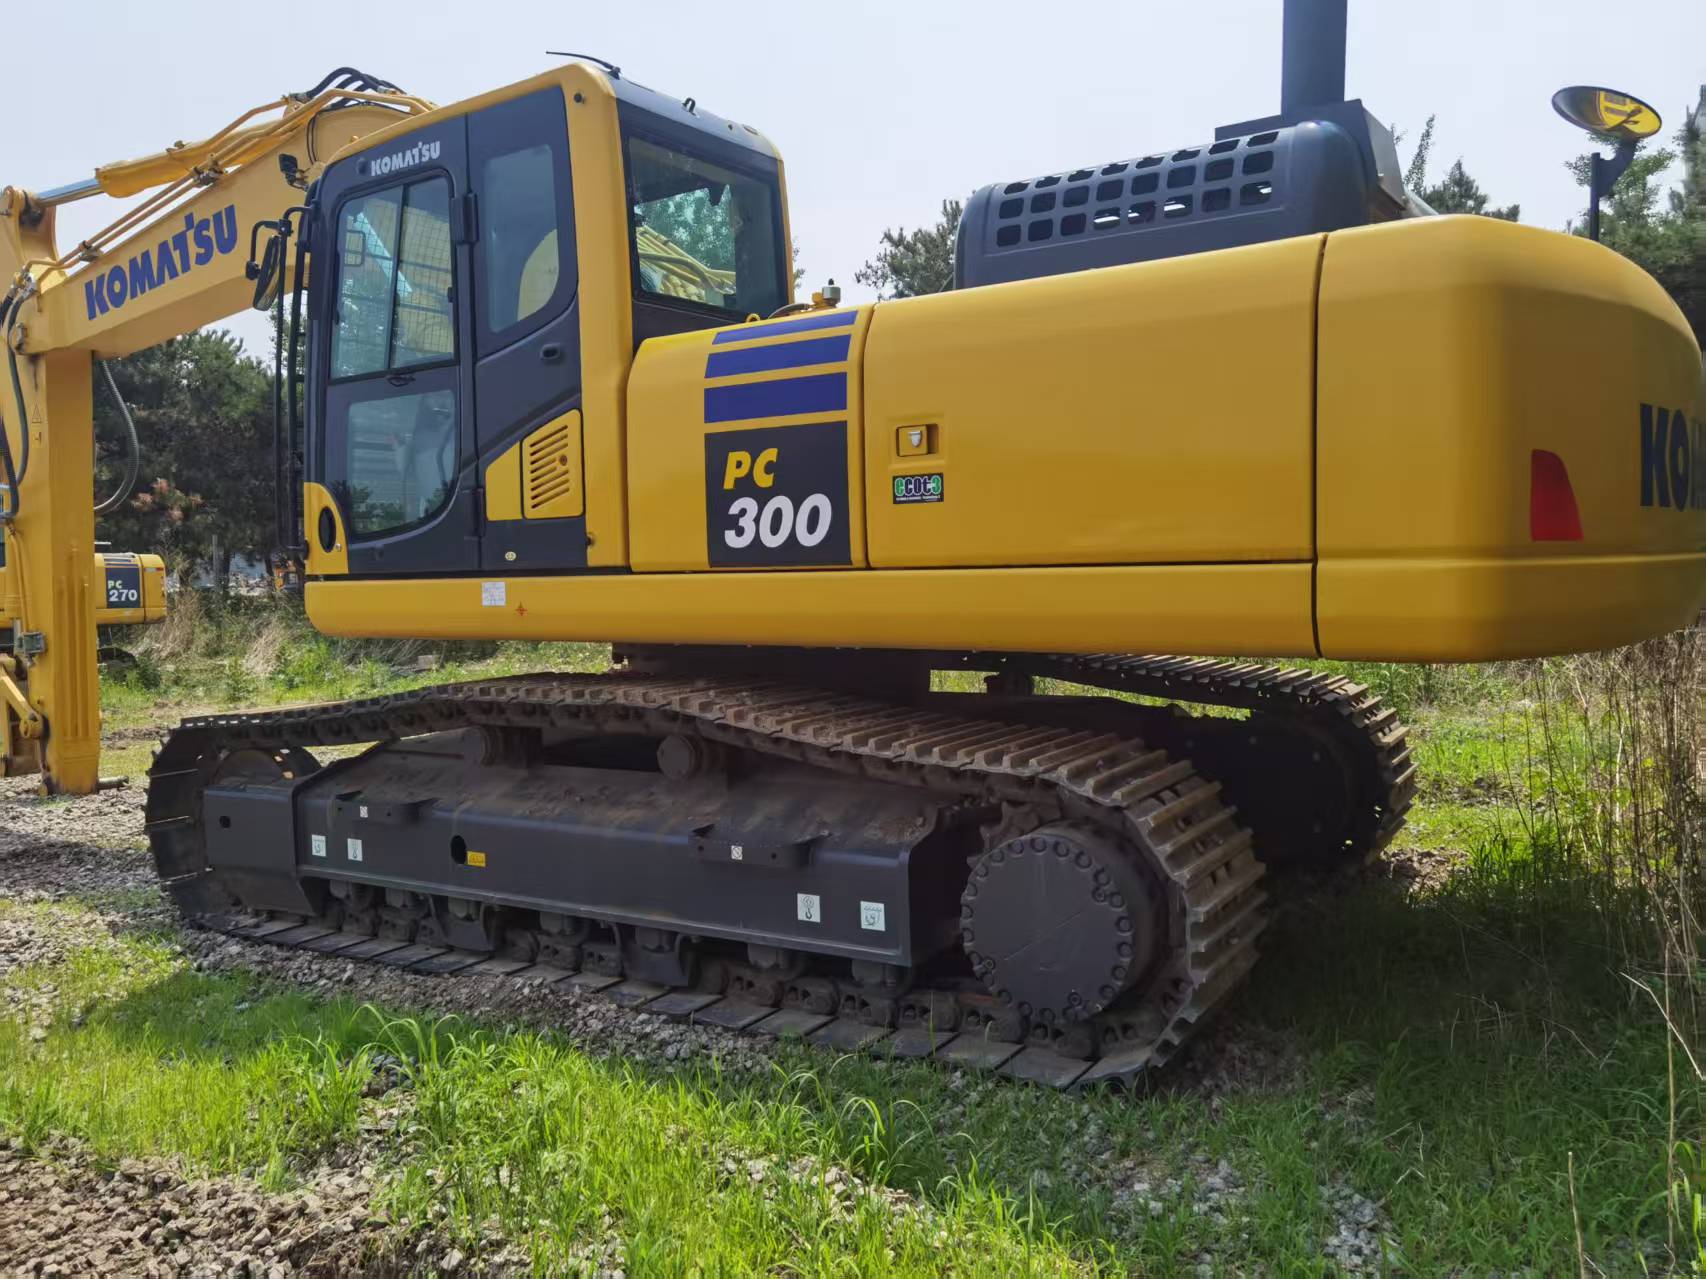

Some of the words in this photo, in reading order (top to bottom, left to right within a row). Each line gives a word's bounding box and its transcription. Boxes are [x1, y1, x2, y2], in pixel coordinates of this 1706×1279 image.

[371, 141, 440, 176] KOMATSU
[85, 204, 237, 320] KOMATSU
[723, 447, 778, 489] PC
[895, 475, 941, 496] ecot3
[724, 493, 832, 548] 300
[108, 580, 122, 589] PC
[109, 589, 138, 601] 270
